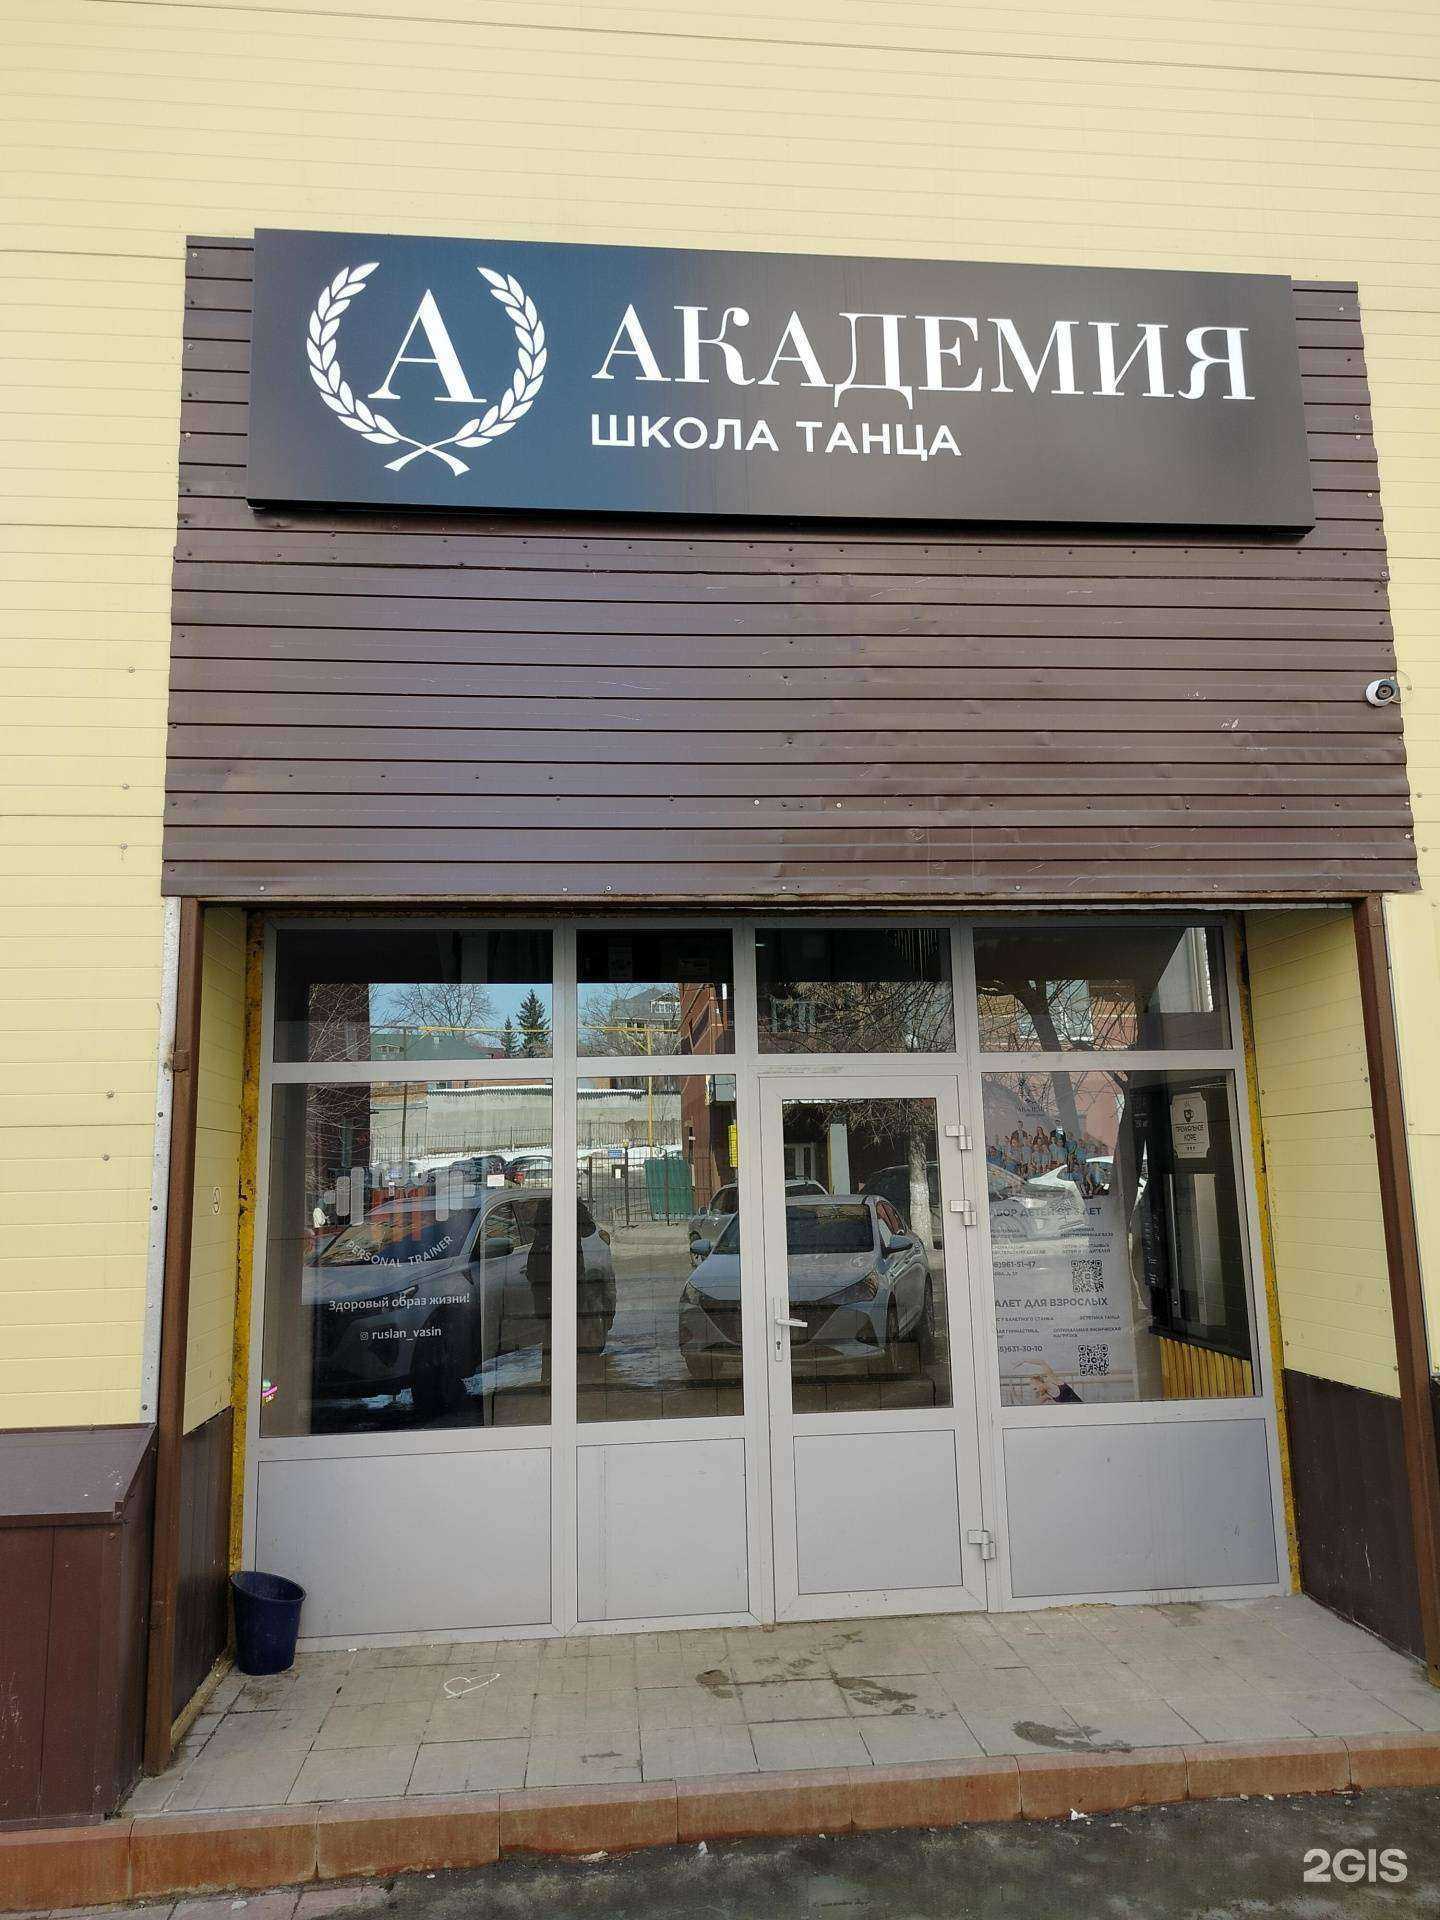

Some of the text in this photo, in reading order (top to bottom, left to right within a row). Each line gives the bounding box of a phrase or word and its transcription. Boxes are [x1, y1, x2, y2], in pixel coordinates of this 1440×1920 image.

[590, 303, 1256, 410] АКАДЕМИЯ
[590, 413, 963, 462] ШКОЛА ТАНЦА
[346, 1234, 454, 1268] PERSONAL TRAINER
[328, 1292, 471, 1313] Здоровый образ жизни!
[1024, 1299, 1047, 1309] ДЛЯ
[1049, 1297, 1109, 1307] ВЗРОСЛЫХ
[371, 1326, 442, 1342] ruslan_vasin
